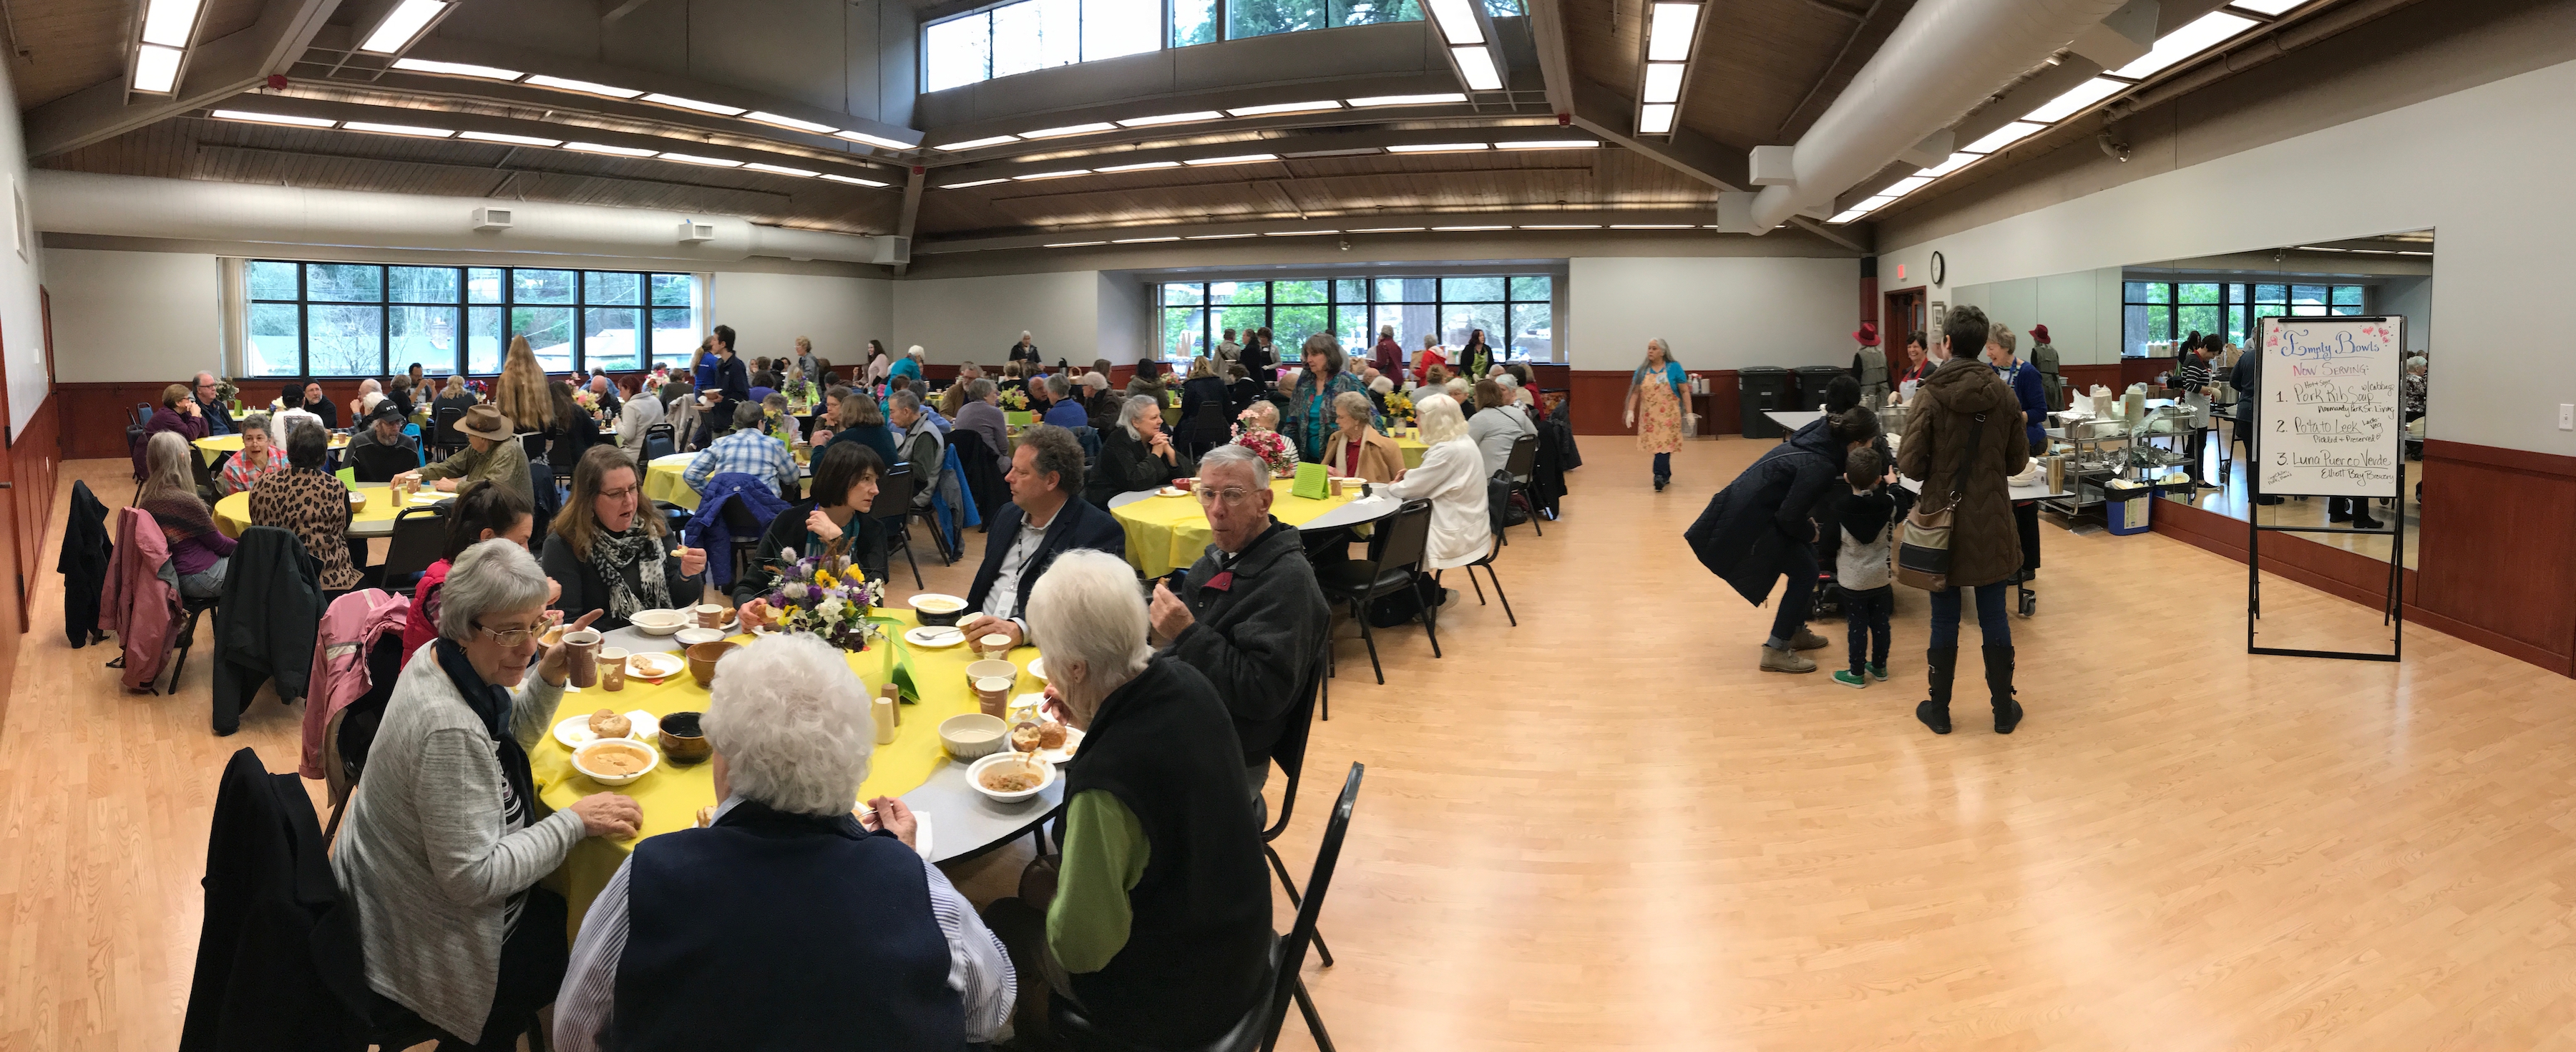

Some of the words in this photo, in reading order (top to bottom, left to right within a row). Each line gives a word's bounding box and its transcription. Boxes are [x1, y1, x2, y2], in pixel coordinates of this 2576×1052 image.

[2280, 329, 2331, 361] Empty
[2335, 331, 2379, 354] Bowls
[2275, 391, 2288, 402] 1.
[2294, 384, 2324, 402] Pork
[2326, 383, 2348, 403] Rib
[2348, 386, 2374, 405] Soup
[2375, 405, 2395, 419] Living
[2277, 419, 2288, 432] 2.
[2295, 417, 2331, 433] Potato
[2336, 419, 2363, 434] Leek
[2313, 434, 2338, 443] Pickled
[2346, 434, 2375, 443] Preserved
[2277, 452, 2288, 465] 3.
[2293, 452, 2320, 465] Luna
[2361, 448, 2391, 467] Verde
[2321, 468, 2345, 479] Elliott
[2348, 469, 2366, 487] Bay
[2364, 470, 2394, 484] Brewery
